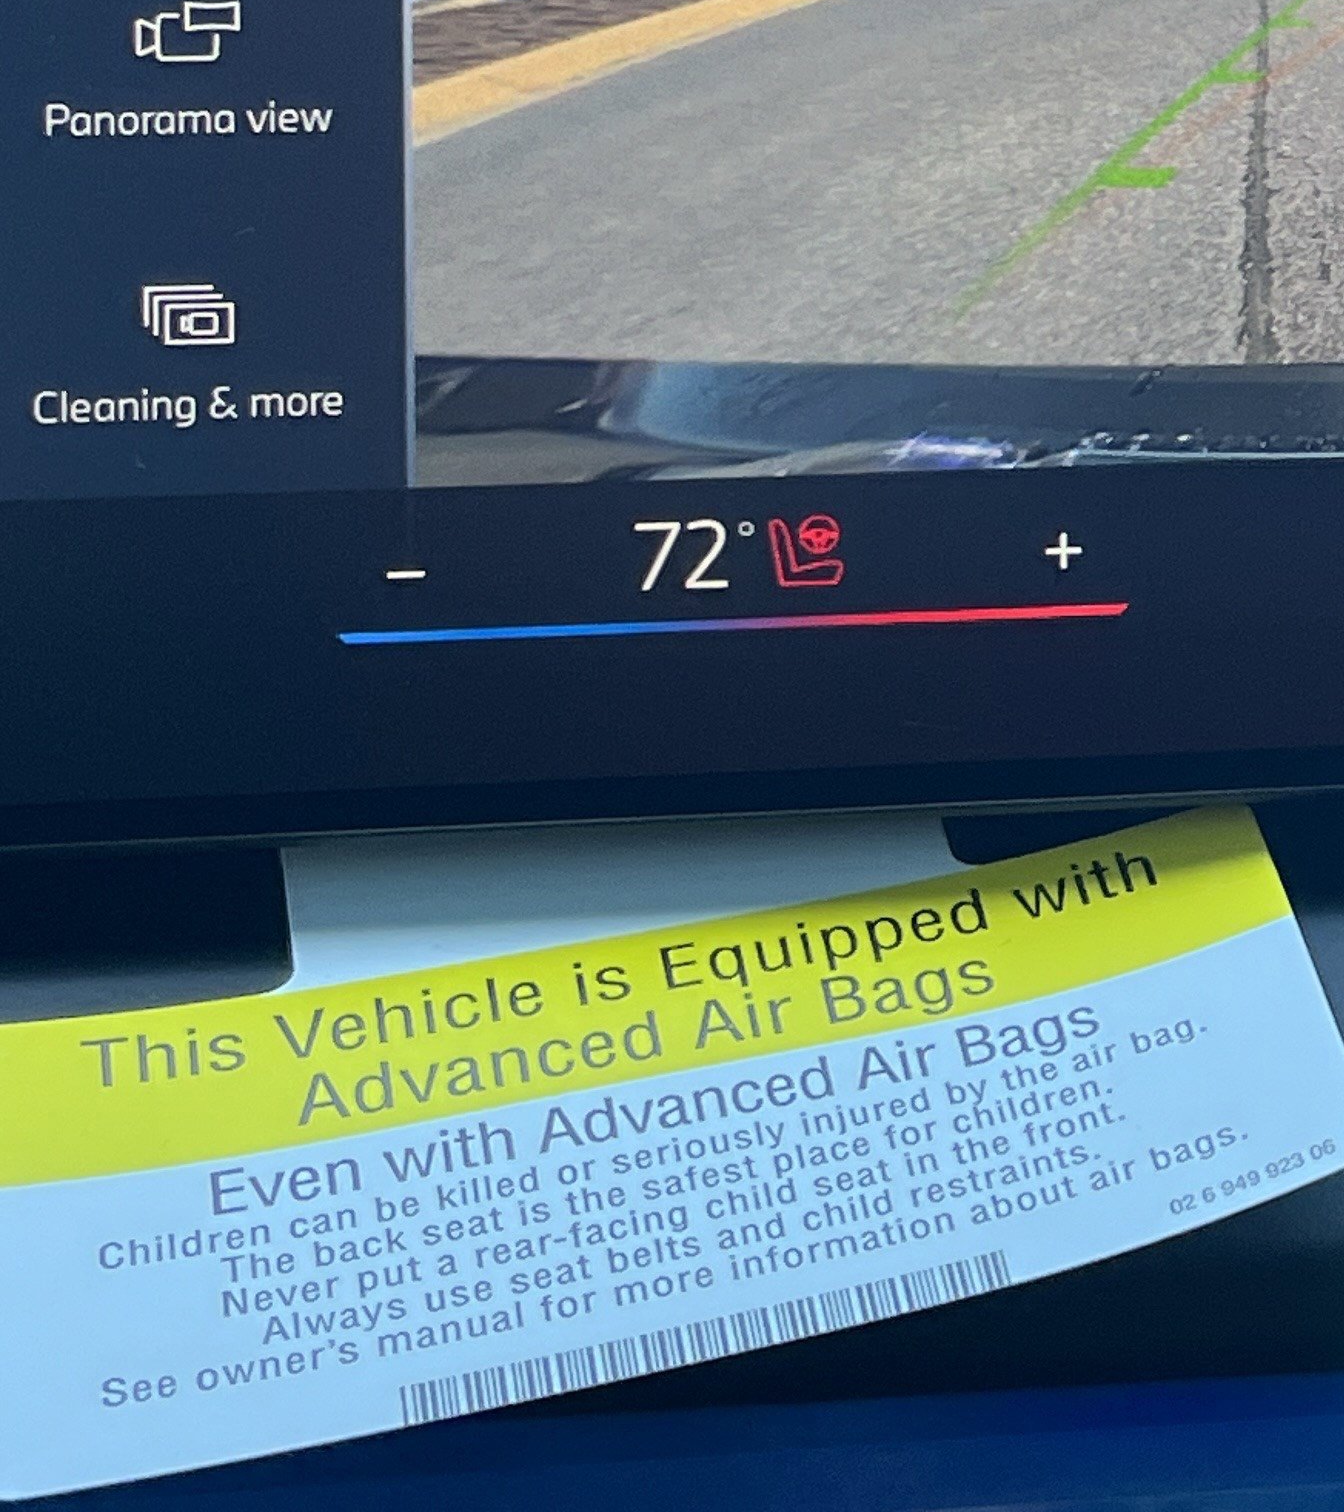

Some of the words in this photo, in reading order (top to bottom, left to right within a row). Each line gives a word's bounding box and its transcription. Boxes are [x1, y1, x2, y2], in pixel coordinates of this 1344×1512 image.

[44, 102, 236, 137] Panorama
[244, 99, 333, 134] view
[32, 386, 197, 428] Cleaning
[210, 386, 239, 420] &
[248, 385, 344, 418] more
[80, 1028, 246, 1088] This
[273, 977, 544, 1059] Vehicle
[573, 962, 631, 1006] is
[660, 887, 989, 989] Equipped
[1012, 851, 1158, 918] with
[298, 1010, 662, 1126] Advanced
[695, 992, 792, 1049] Air
[820, 959, 995, 1025] Bags
[99, 1223, 271, 1269] Children
[290, 1207, 357, 1238] can
[375, 1196, 420, 1223] be
[437, 1166, 540, 1210] killed
[558, 1159, 596, 1186] or
[612, 1121, 784, 1174] seriously
[800, 1088, 931, 1137] injured
[945, 1078, 987, 1106] by
[1001, 1061, 1058, 1091] the
[1072, 1042, 1117, 1073] air
[1129, 1018, 1208, 1054] bag.
[210, 1156, 361, 1216] Even
[382, 1121, 516, 1182] with
[540, 1055, 834, 1154] Advanced
[857, 1040, 936, 1090] Air
[956, 1006, 1100, 1067] Bags
[221, 1252, 295, 1282] The
[314, 1228, 407, 1267] back
[421, 1207, 504, 1246] seat
[519, 1200, 551, 1226] is
[566, 1185, 626, 1216] the
[642, 1155, 758, 1200] safest
[773, 1135, 870, 1179] place
[885, 1120, 937, 1150] for
[953, 1080, 1113, 1134] children.
[222, 1275, 339, 1318] Never
[358, 1256, 422, 1298] put
[437, 1253, 458, 1277] a
[475, 1204, 690, 1270] rear-facing
[706, 1177, 797, 1220] child
[814, 1158, 892, 1198] seat
[904, 1150, 939, 1177] in
[952, 1134, 1011, 1165] the
[1023, 1101, 1126, 1147] front.
[1169, 1192, 1197, 1215] 02
[1202, 1186, 1217, 1205] 6
[1221, 1169, 1261, 1197] 949
[1265, 1150, 1306, 1178] 923
[1309, 1137, 1337, 1161] 06
[102, 1374, 177, 1407] See
[196, 1338, 359, 1391] owner's
[378, 1299, 524, 1358] manual
[541, 1289, 597, 1322] for
[614, 1265, 714, 1307] more
[731, 1210, 956, 1281] information
[970, 1175, 1078, 1225] about
[1090, 1157, 1136, 1192] air
[1149, 1125, 1249, 1171] bags.
[262, 1297, 407, 1345] Always
[425, 1280, 493, 1313] use
[510, 1253, 592, 1295] seat
[607, 1235, 701, 1274] belts
[718, 1211, 786, 1250] and
[803, 1188, 893, 1232] child
[911, 1143, 1101, 1208] restraints.
